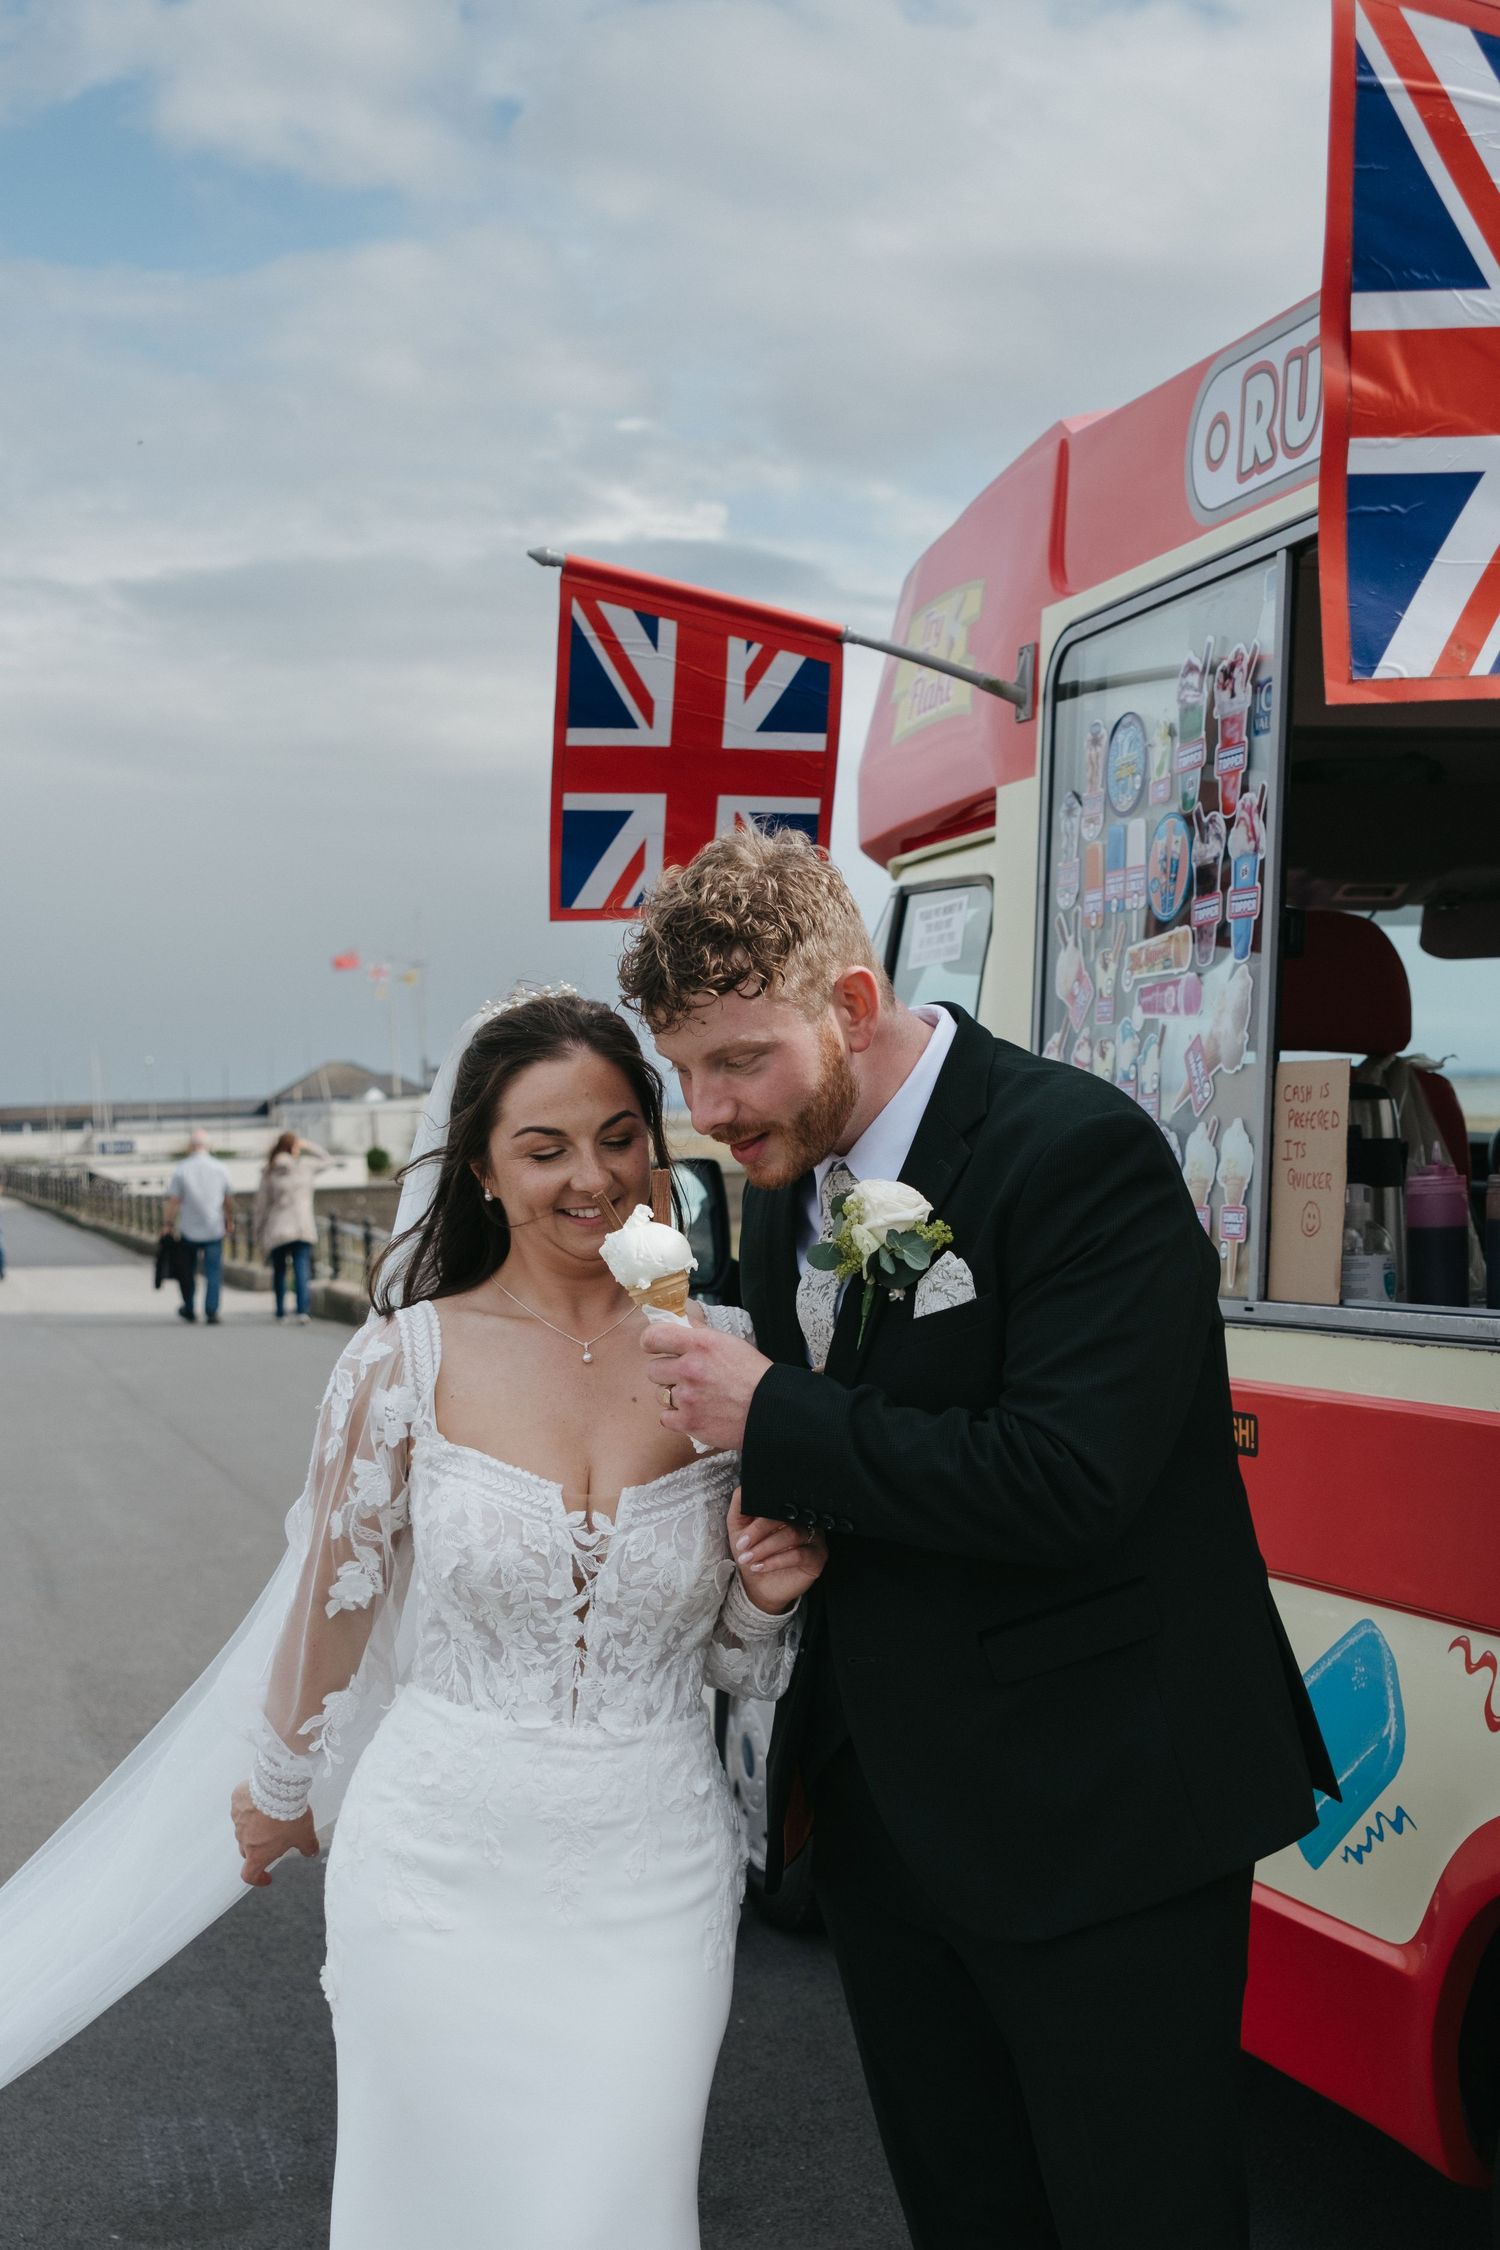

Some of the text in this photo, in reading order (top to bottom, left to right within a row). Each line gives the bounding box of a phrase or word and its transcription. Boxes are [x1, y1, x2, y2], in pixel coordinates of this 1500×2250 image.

[1283, 1082, 1330, 1103] CASH IS
[1288, 1108, 1340, 1131] PREFERED
[1281, 1139, 1307, 1161] ITS
[1287, 1168, 1333, 1192] QUICKER
